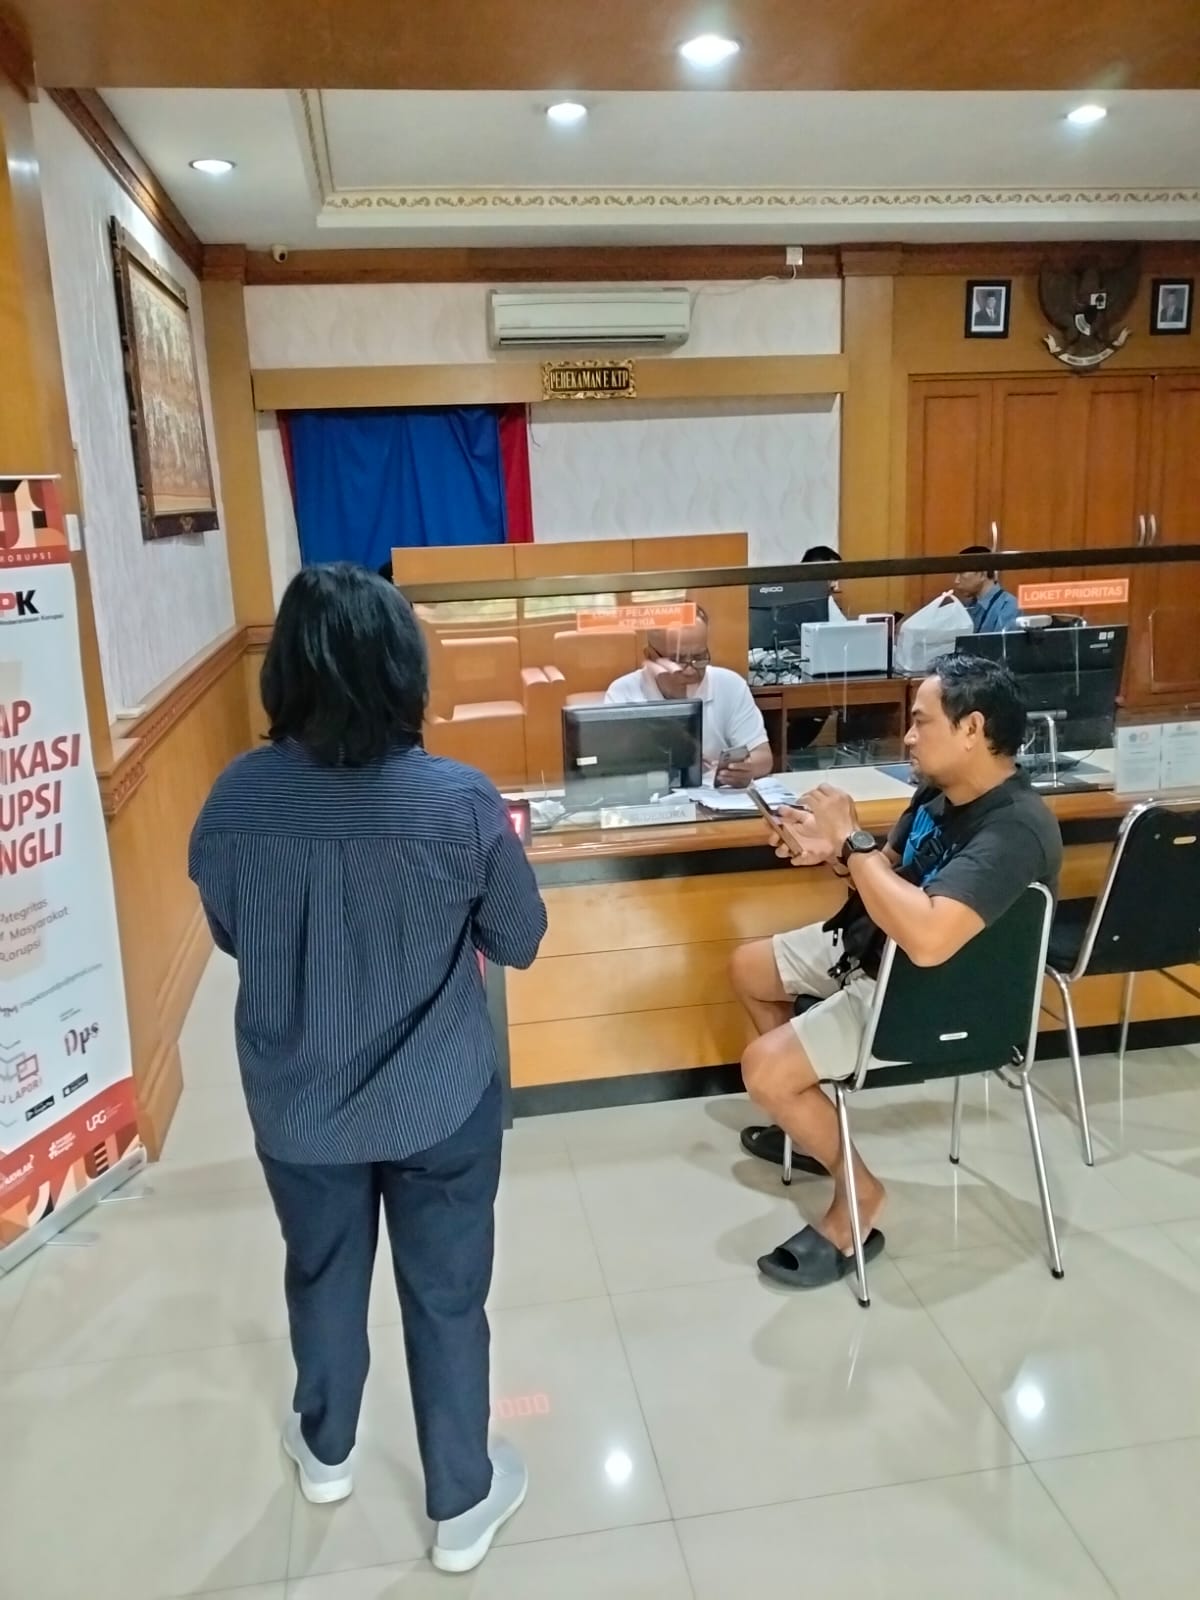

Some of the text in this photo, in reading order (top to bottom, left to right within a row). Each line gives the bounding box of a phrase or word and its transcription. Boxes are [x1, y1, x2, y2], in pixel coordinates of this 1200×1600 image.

[550, 371, 601, 388] PEREKAMAN
[611, 370, 629, 387] KTP
[1024, 586, 1122, 601] LOKET PRIORITAS
[10, 906, 69, 940] Masyarakat
